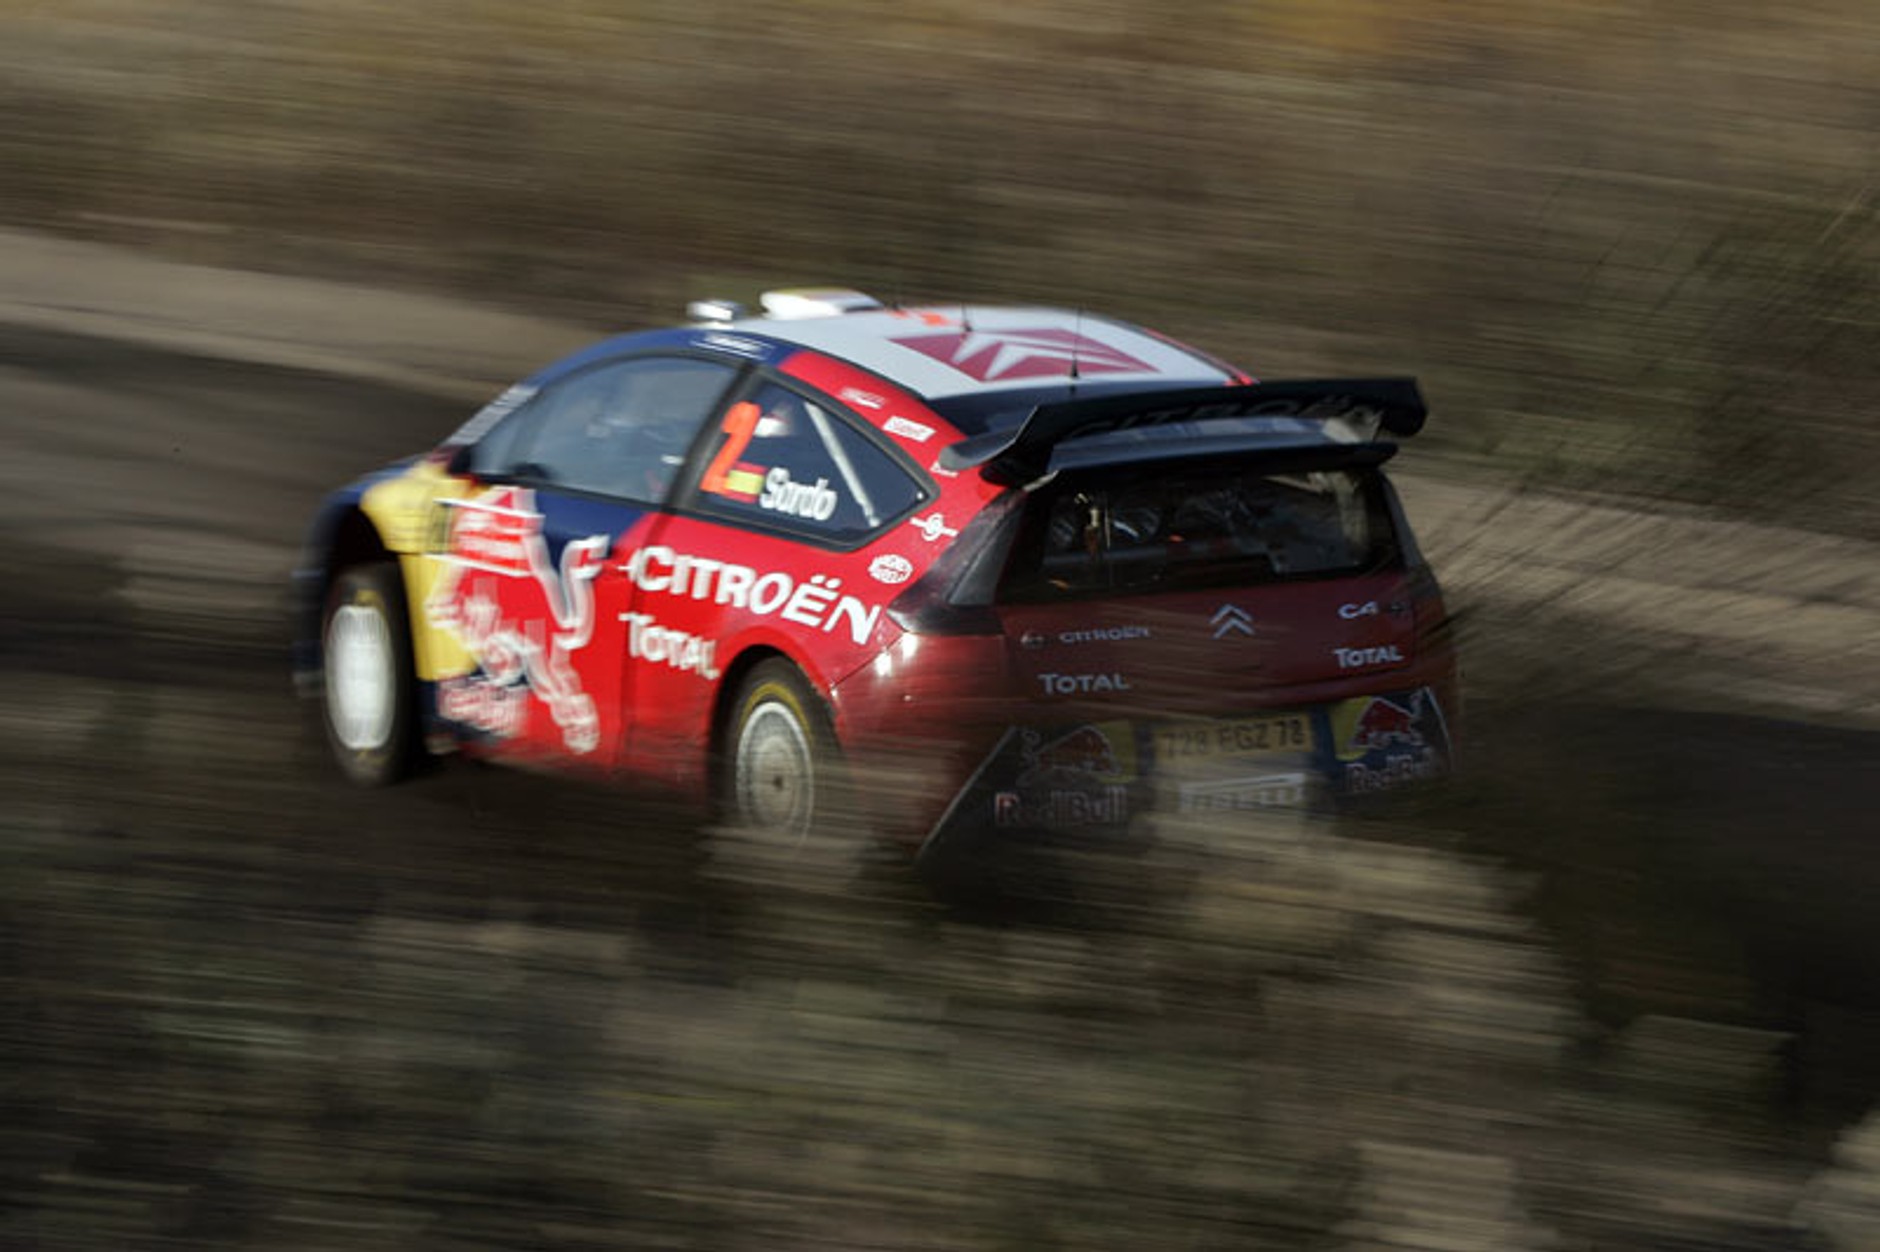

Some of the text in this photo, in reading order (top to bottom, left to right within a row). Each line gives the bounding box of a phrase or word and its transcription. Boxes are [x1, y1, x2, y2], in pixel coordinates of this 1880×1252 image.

[700, 401, 762, 495] 2
[759, 467, 837, 520] Sordo
[627, 544, 881, 646] CITROËN
[1337, 600, 1379, 620] C4
